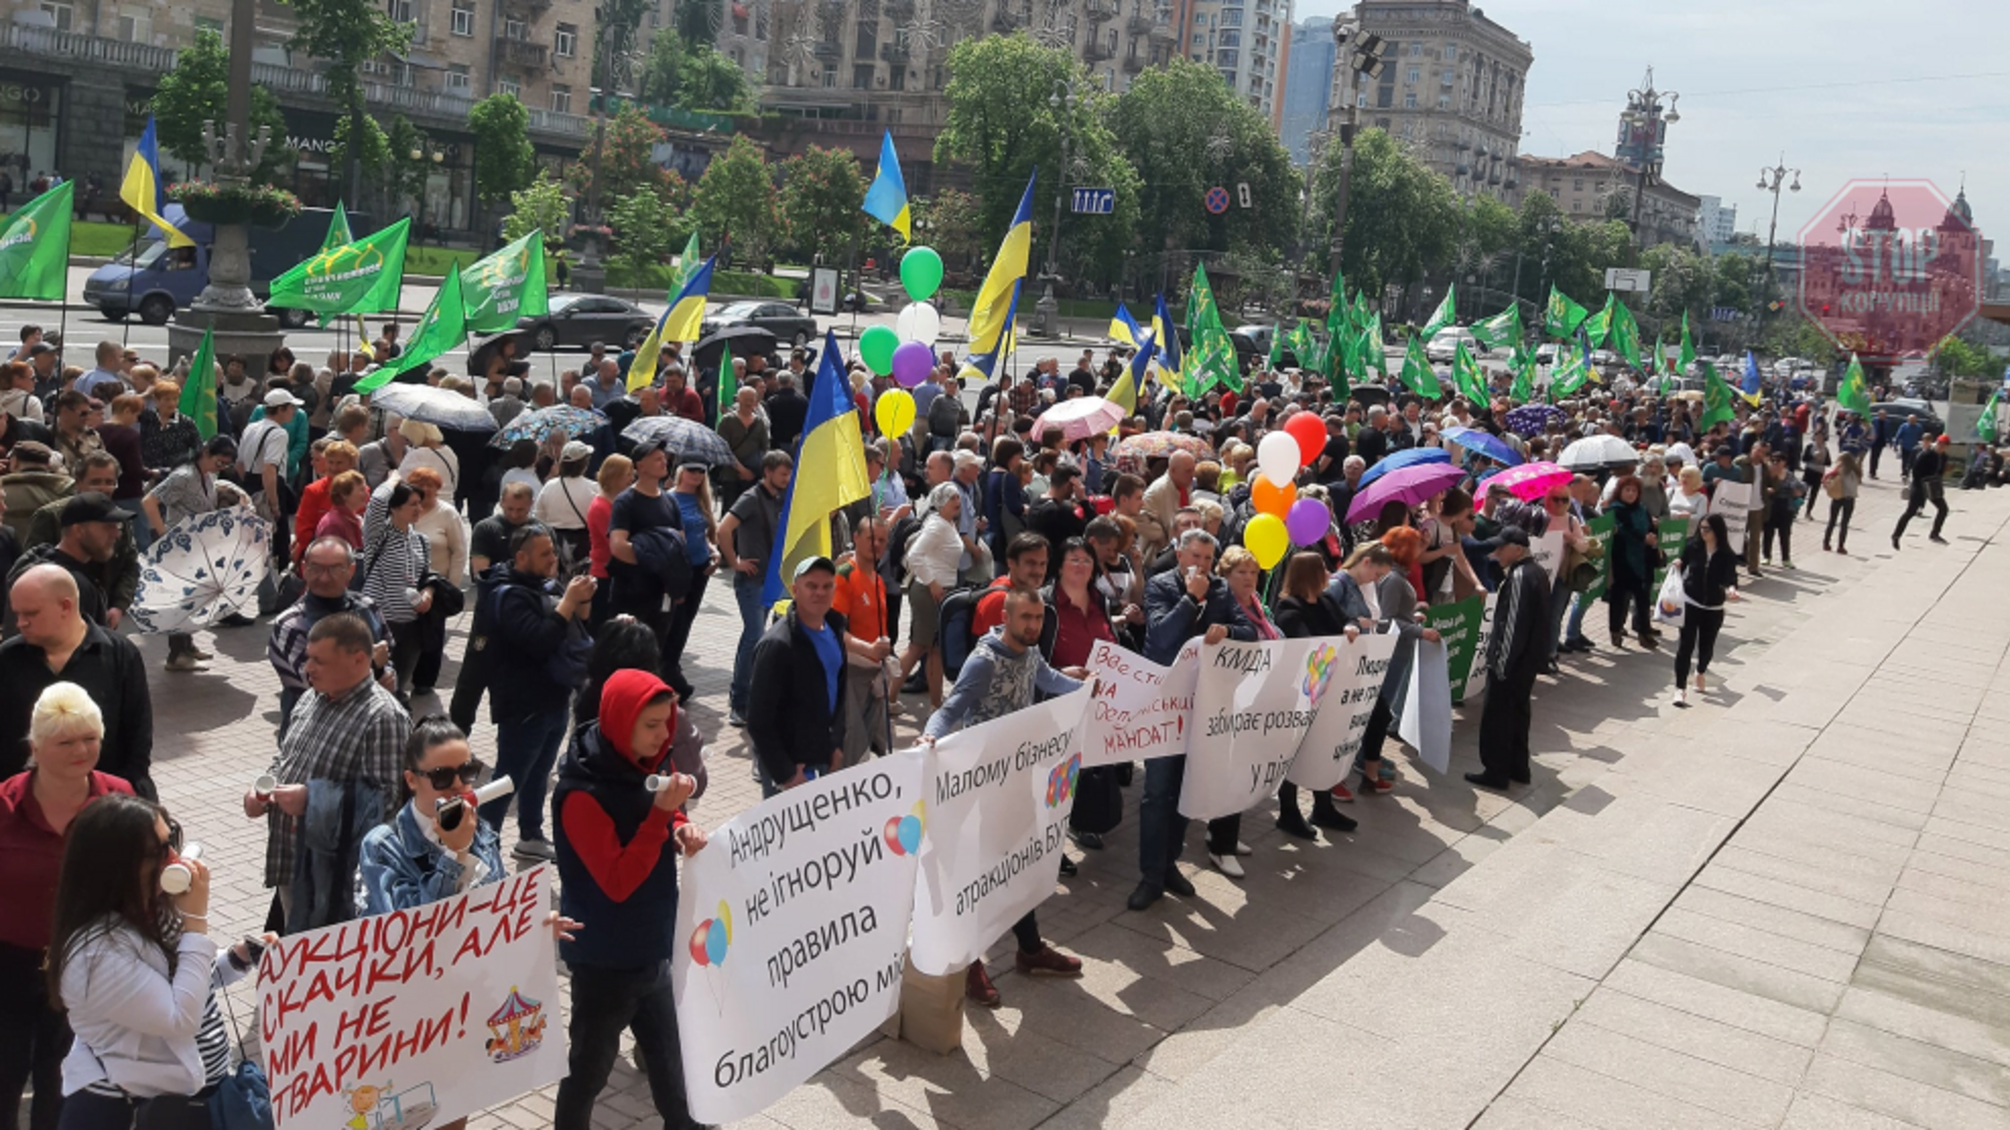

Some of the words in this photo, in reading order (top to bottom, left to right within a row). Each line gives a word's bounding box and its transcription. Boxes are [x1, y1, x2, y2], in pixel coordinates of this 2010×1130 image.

[1213, 646, 1271, 675] КМДА
[936, 757, 1010, 806] Малому
[1015, 728, 1074, 771] бізнесу
[1206, 707, 1263, 738] забирає
[729, 773, 901, 868] Андрущенко,
[746, 888, 770, 925] не
[769, 827, 883, 907] ігноруй
[957, 836, 1043, 916] атракціонів
[263, 939, 444, 1043] СКАЧКИ,
[451, 901, 538, 966] АЛЕ
[767, 906, 877, 988] правила
[268, 1021, 317, 1089] МИ
[334, 995, 397, 1050] НЕ
[272, 991, 470, 1127] ТВАРИНИ!
[714, 979, 868, 1088] благоустрою
